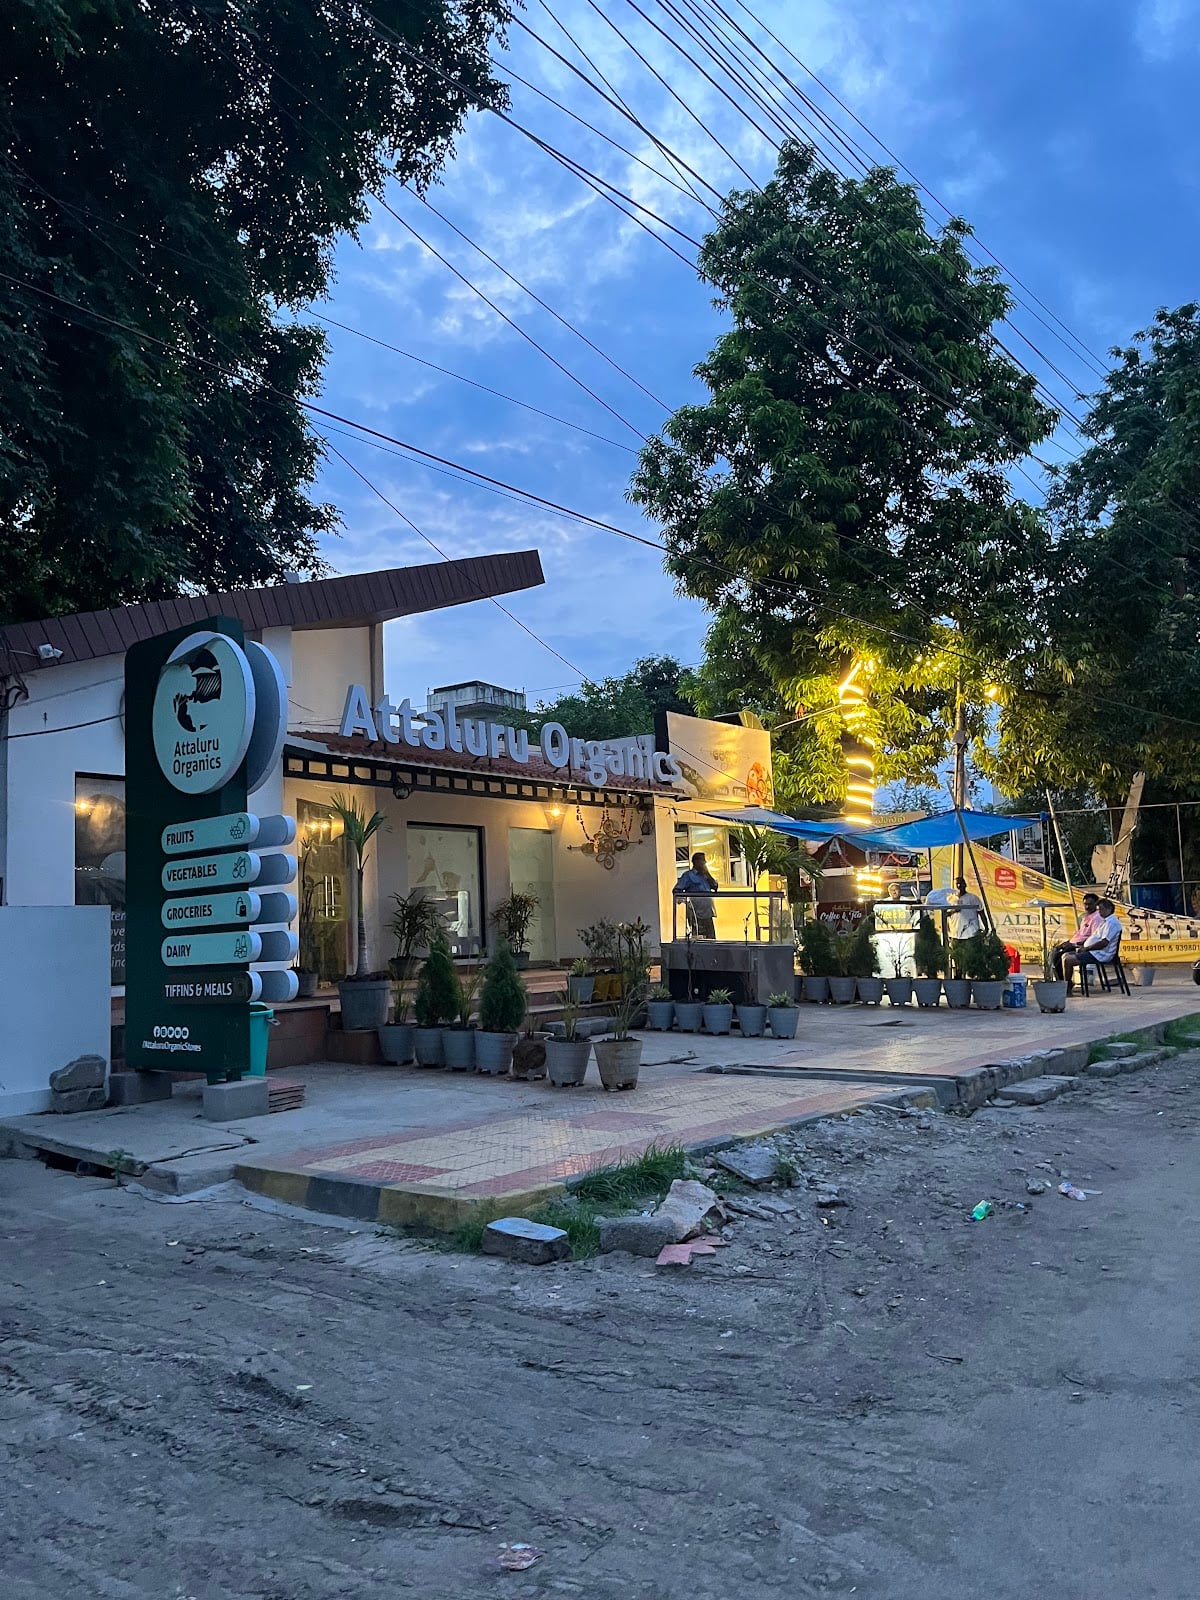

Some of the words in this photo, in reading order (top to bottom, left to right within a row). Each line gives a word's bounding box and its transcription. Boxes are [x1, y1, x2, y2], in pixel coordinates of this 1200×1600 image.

[339, 683, 529, 763] Attaluru
[540, 721, 682, 787] Organics
[174, 737, 219, 757] Attaluru
[173, 754, 221, 778] Organics
[166, 830, 194, 846] FRUITS
[166, 863, 217, 882] VEGETABLES
[166, 904, 212, 921] GROCERIES
[166, 944, 191, 958] DAIRY
[165, 984, 194, 998] TIFFINS
[195, 984, 203, 996] &
[204, 983, 233, 996] MEALS
